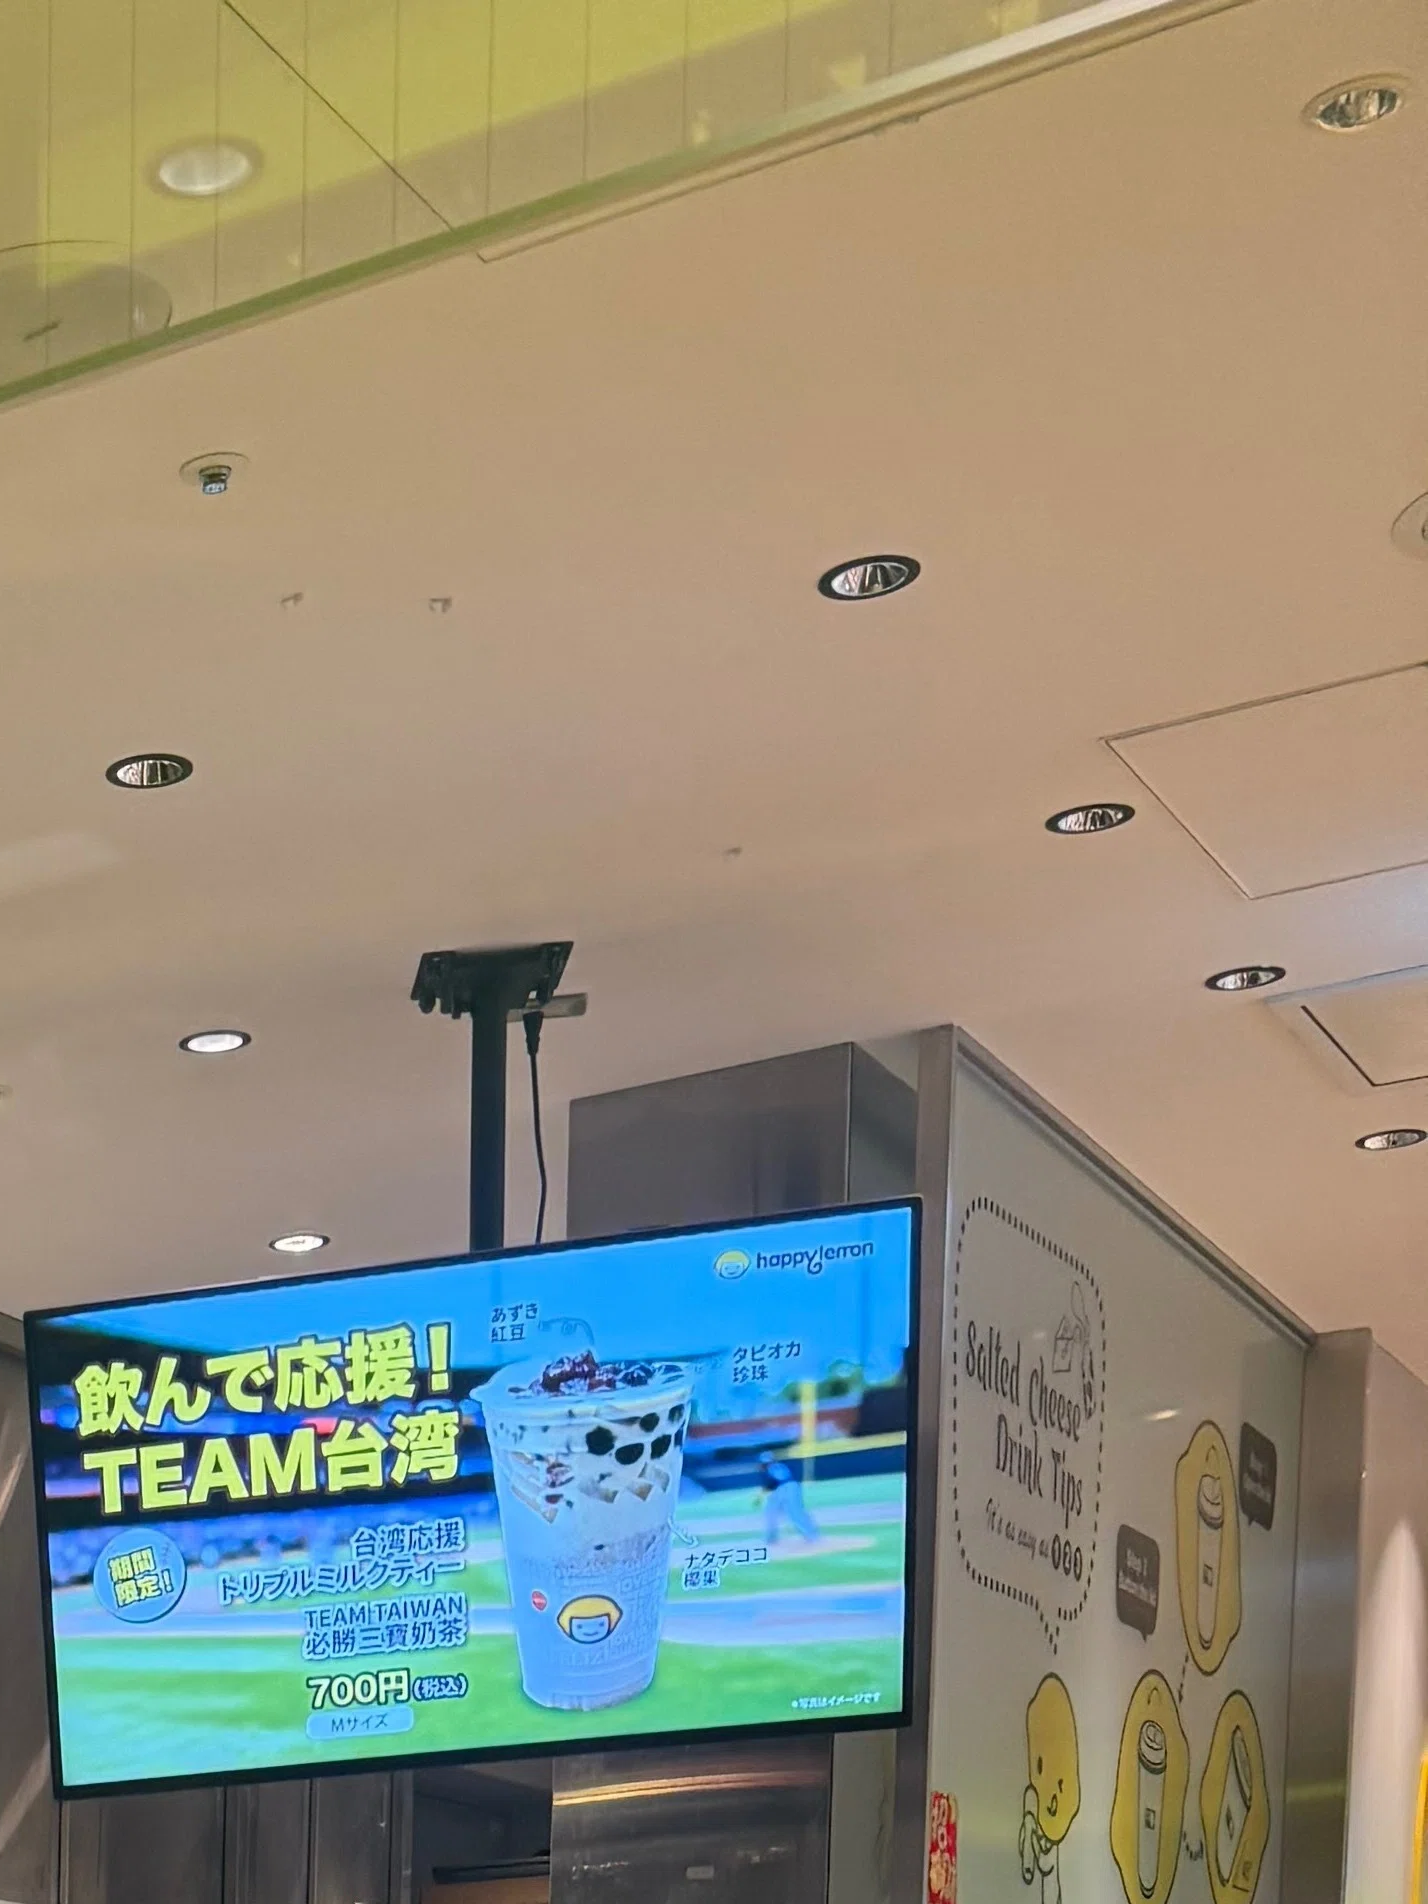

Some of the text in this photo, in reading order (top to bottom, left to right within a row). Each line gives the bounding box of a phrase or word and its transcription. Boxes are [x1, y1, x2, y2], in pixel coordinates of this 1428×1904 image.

[81, 1410, 462, 1517] TEAM台湾
[995, 1412, 1043, 1499] Drink
[352, 1520, 464, 1560] 台湾応援
[305, 1595, 464, 1630] TEAM TAIWAN
[307, 1669, 410, 1709] 700円
[331, 1714, 389, 1733] Mサイズ
